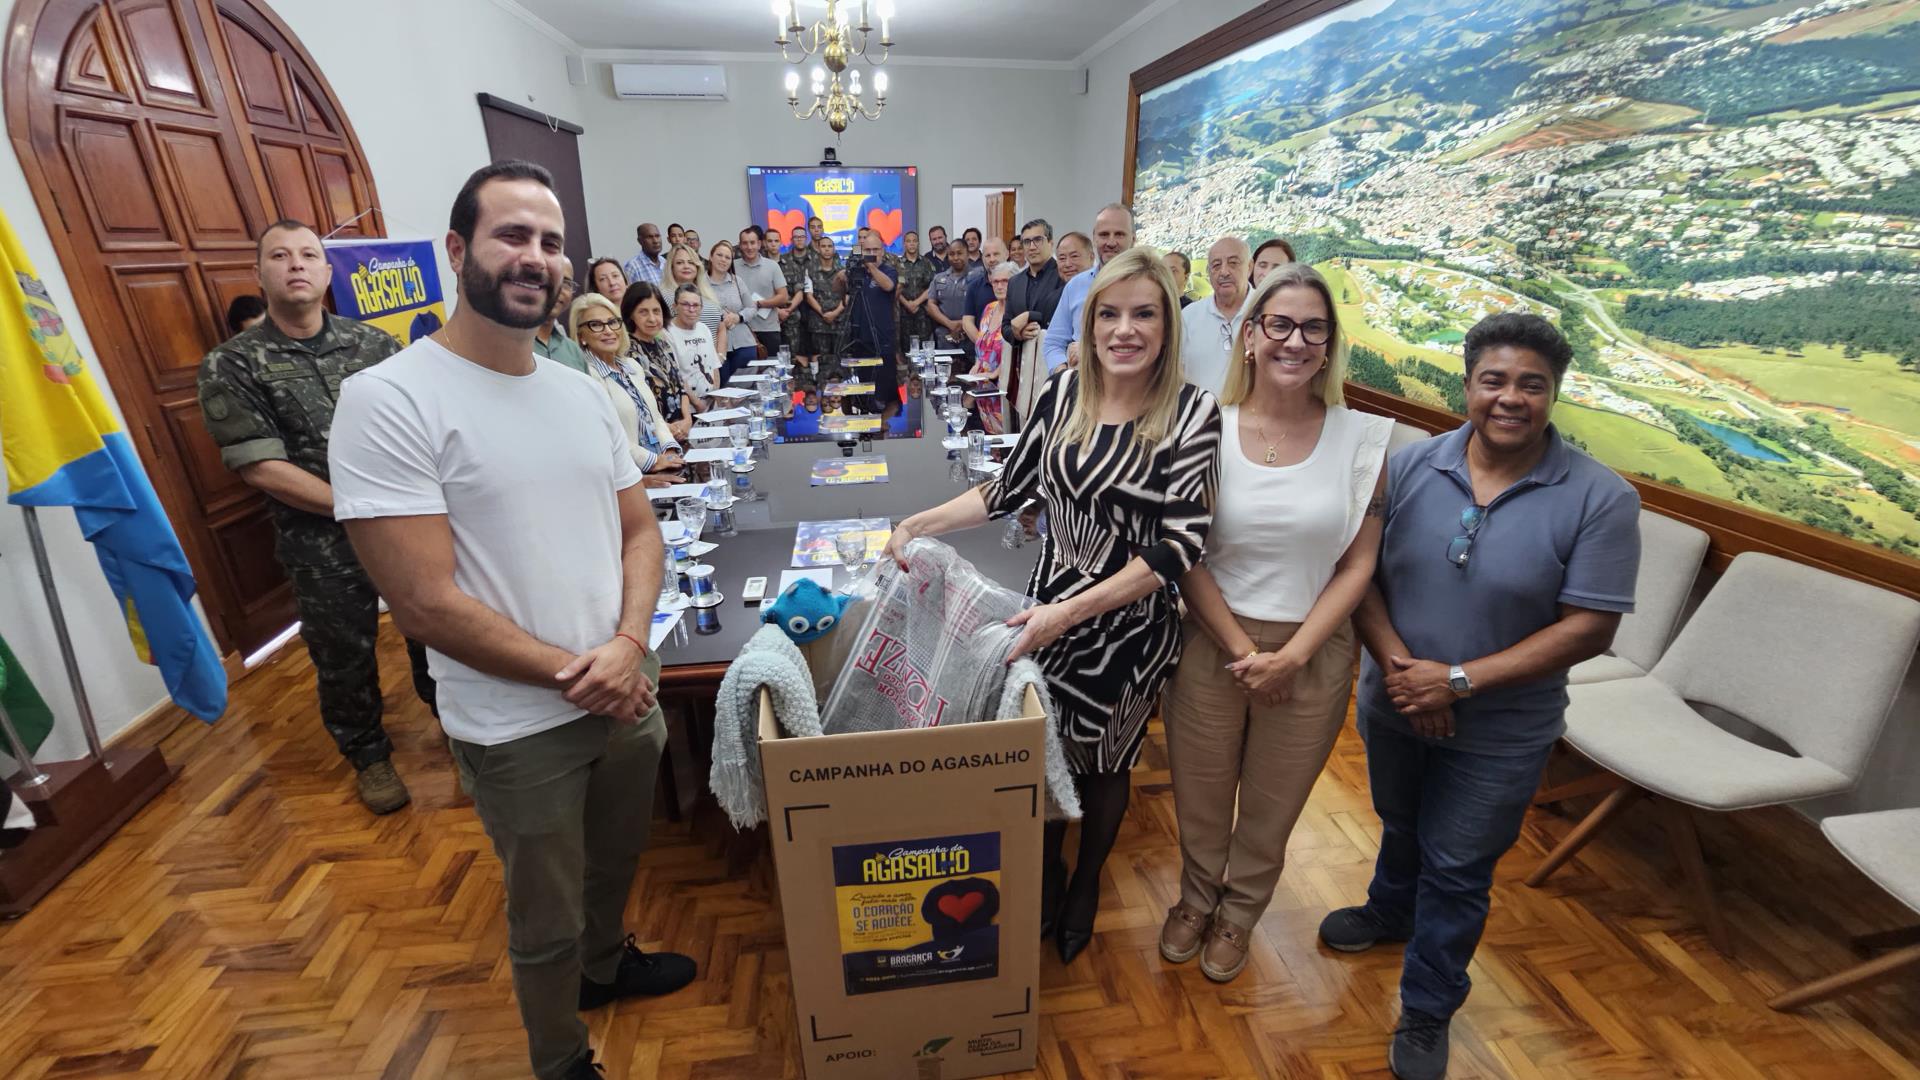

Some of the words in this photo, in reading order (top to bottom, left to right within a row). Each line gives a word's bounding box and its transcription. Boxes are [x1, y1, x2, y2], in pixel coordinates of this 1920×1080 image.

[368, 257, 407, 275] Campanha
[407, 256, 416, 266] do
[351, 265, 427, 315] AGASALHO
[789, 762, 894, 783] CAMPANHA
[899, 759, 926, 774] DO
[931, 749, 1030, 771] AGASALHO
[888, 844, 949, 860] Campanha
[950, 843, 964, 851] do
[862, 849, 971, 883] AGASALHO
[853, 906, 861, 919] O
[863, 902, 914, 918] CORAÇÃO
[856, 920, 869, 932] SE
[890, 952, 933, 966] BRAGANÇA
[825, 1049, 877, 1063] APOIO:
